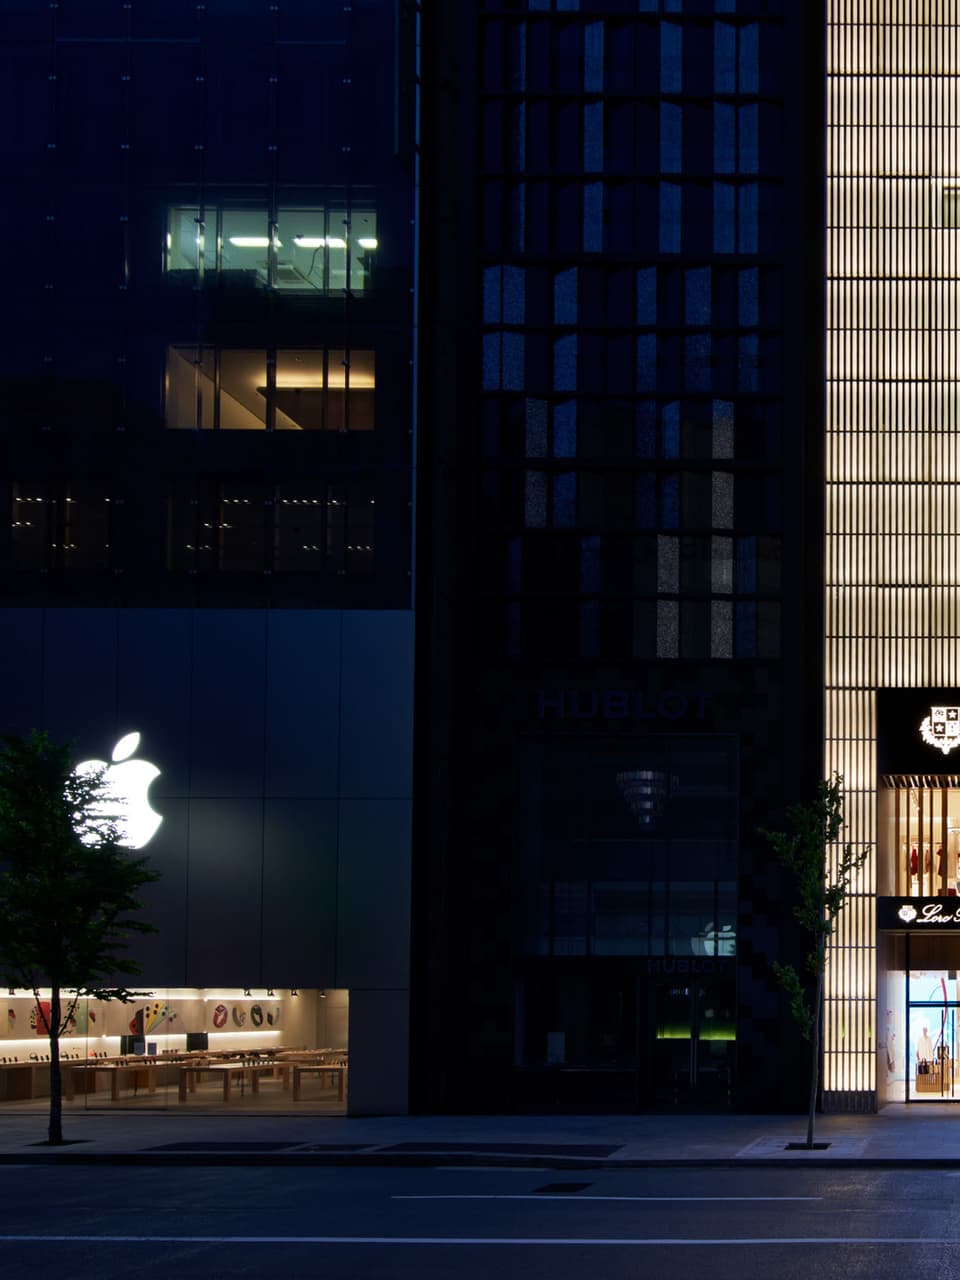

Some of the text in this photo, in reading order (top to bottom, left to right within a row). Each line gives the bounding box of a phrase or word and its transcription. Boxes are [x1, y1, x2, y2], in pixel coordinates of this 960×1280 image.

[536, 689, 711, 720] HUBLOT
[916, 904, 953, 923] Loro
[648, 959, 728, 974] HUBLOT
